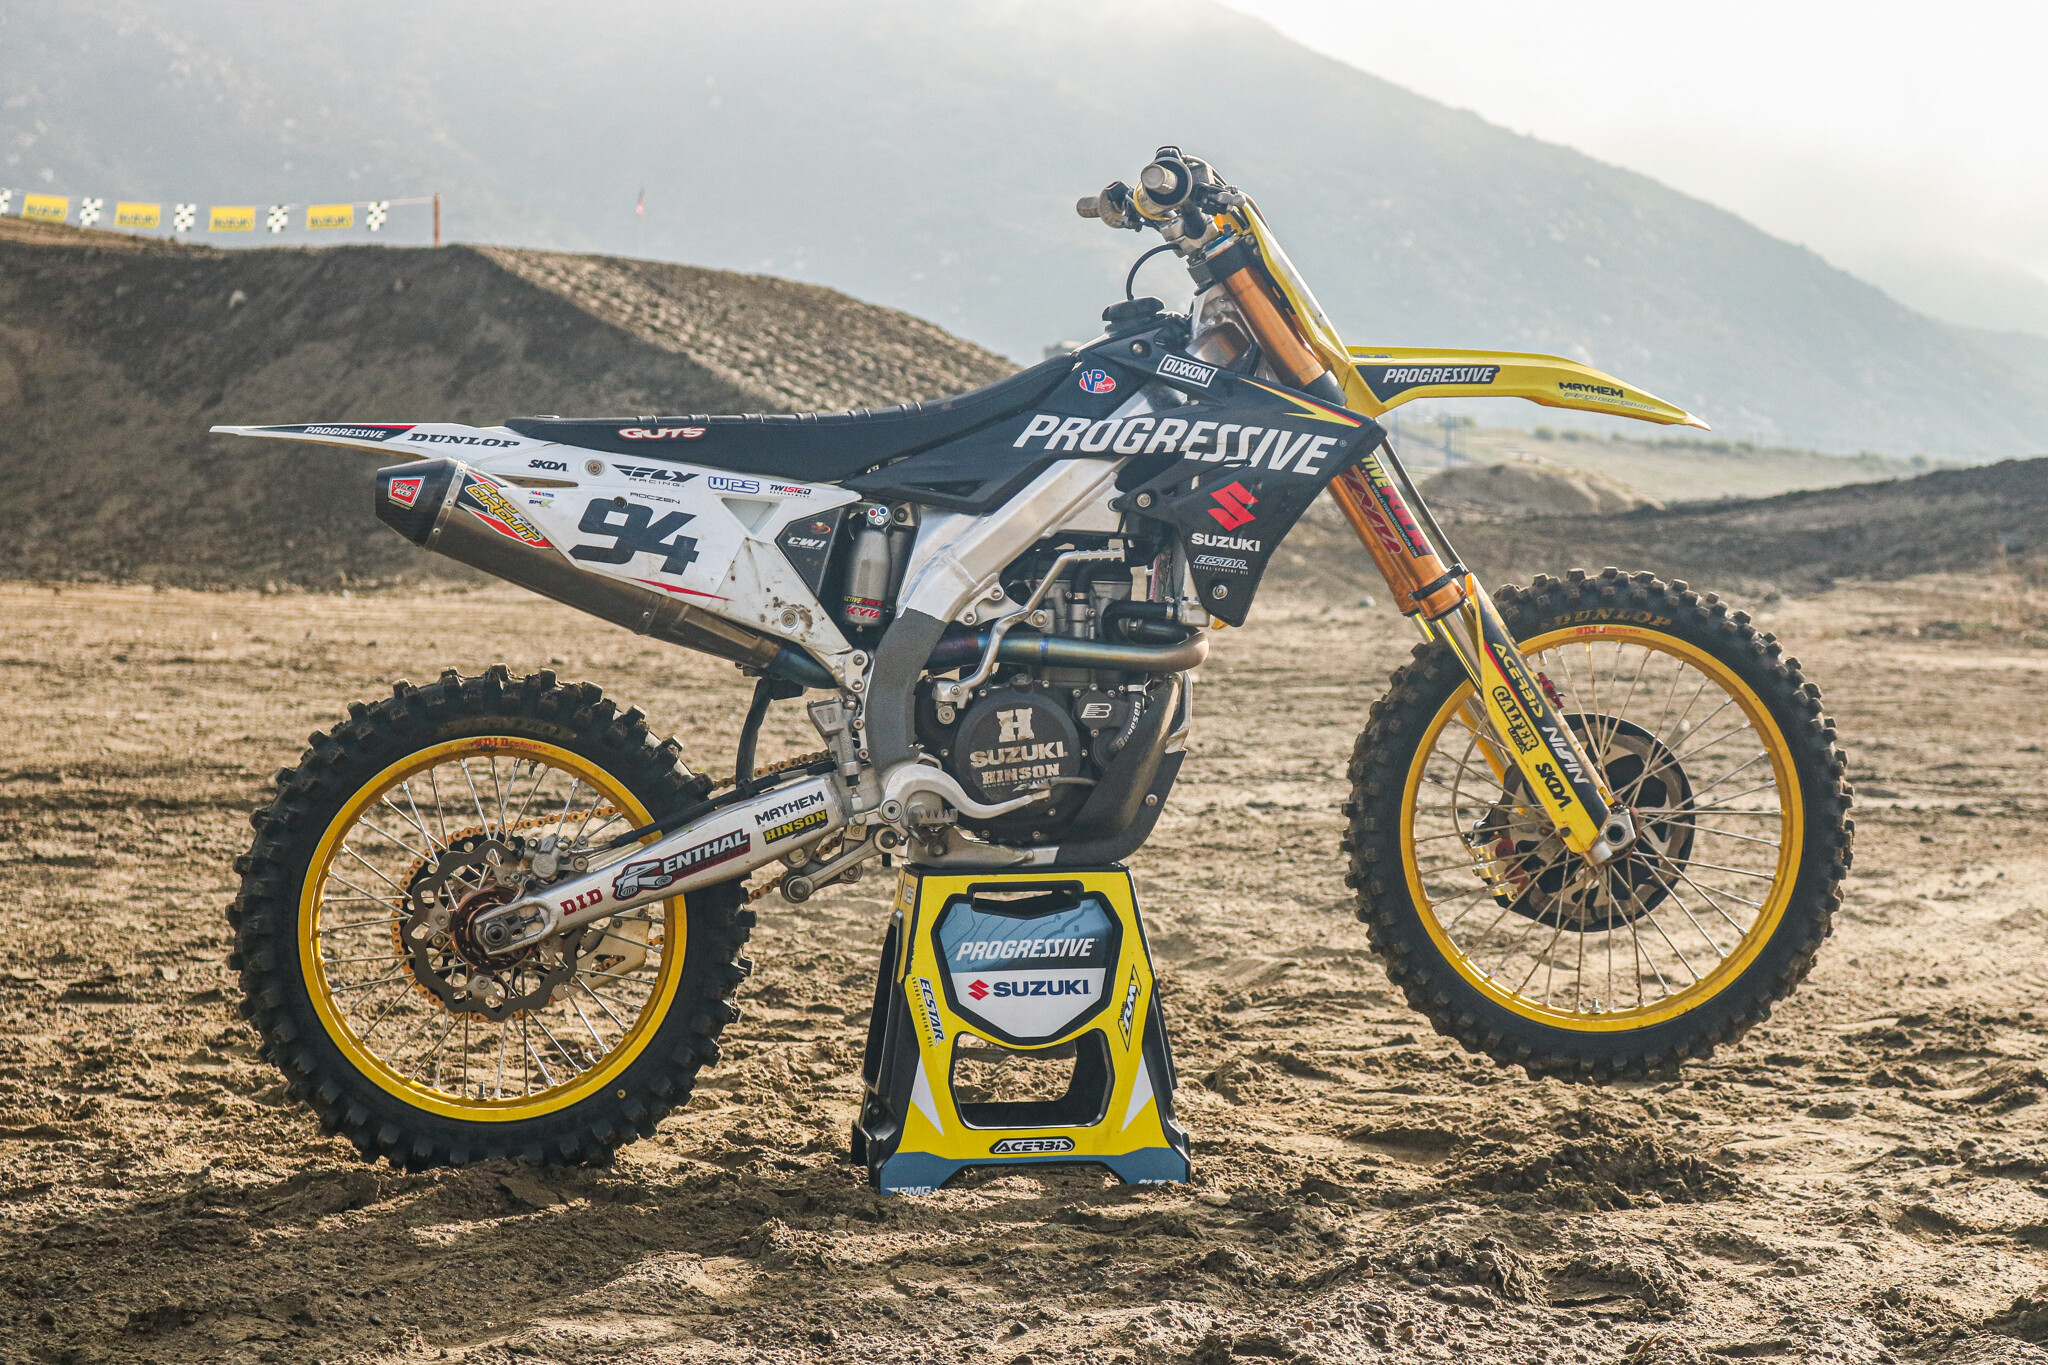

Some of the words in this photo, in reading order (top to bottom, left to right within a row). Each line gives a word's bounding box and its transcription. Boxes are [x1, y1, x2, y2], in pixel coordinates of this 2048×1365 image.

[1163, 358, 1211, 382] DIXXON
[1383, 367, 1494, 384] PROGRESSIVE
[1082, 369, 1106, 392] VP
[1558, 381, 1624, 398] MAYHEM
[303, 426, 386, 439] PROGRESSIVE
[407, 432, 520, 448] DUNLOP
[618, 426, 706, 440] GUTS
[1013, 414, 1338, 476] PROGRESSIVE
[528, 459, 567, 472] SKDA
[612, 464, 700, 482] FLY
[629, 477, 682, 487] RACING
[708, 476, 759, 495] WPS
[770, 484, 811, 495] TWISTED
[630, 491, 681, 504] ROCZEN
[466, 486, 541, 541] CIRCUIT
[568, 498, 700, 575] 94
[1191, 532, 1261, 552] SUZUKI
[1194, 554, 1248, 570] ECSTAR
[845, 606, 880, 619] KYB
[1555, 607, 1671, 626] DUNLOP
[1493, 686, 1538, 751] GALFER
[1508, 727, 1526, 755] USA
[969, 741, 1065, 768] SUZUKI
[1541, 726, 1589, 784] NISSIN
[981, 763, 1060, 784] HINSON
[1536, 762, 1572, 809] SKDA
[754, 790, 825, 826] MAYHEM
[764, 809, 827, 841] HINSON
[614, 831, 748, 899] RENTHAL
[955, 937, 1096, 961] PROGRESSIVE
[993, 979, 1089, 997] SUZUKI
[918, 975, 946, 1047] ECSTAR
